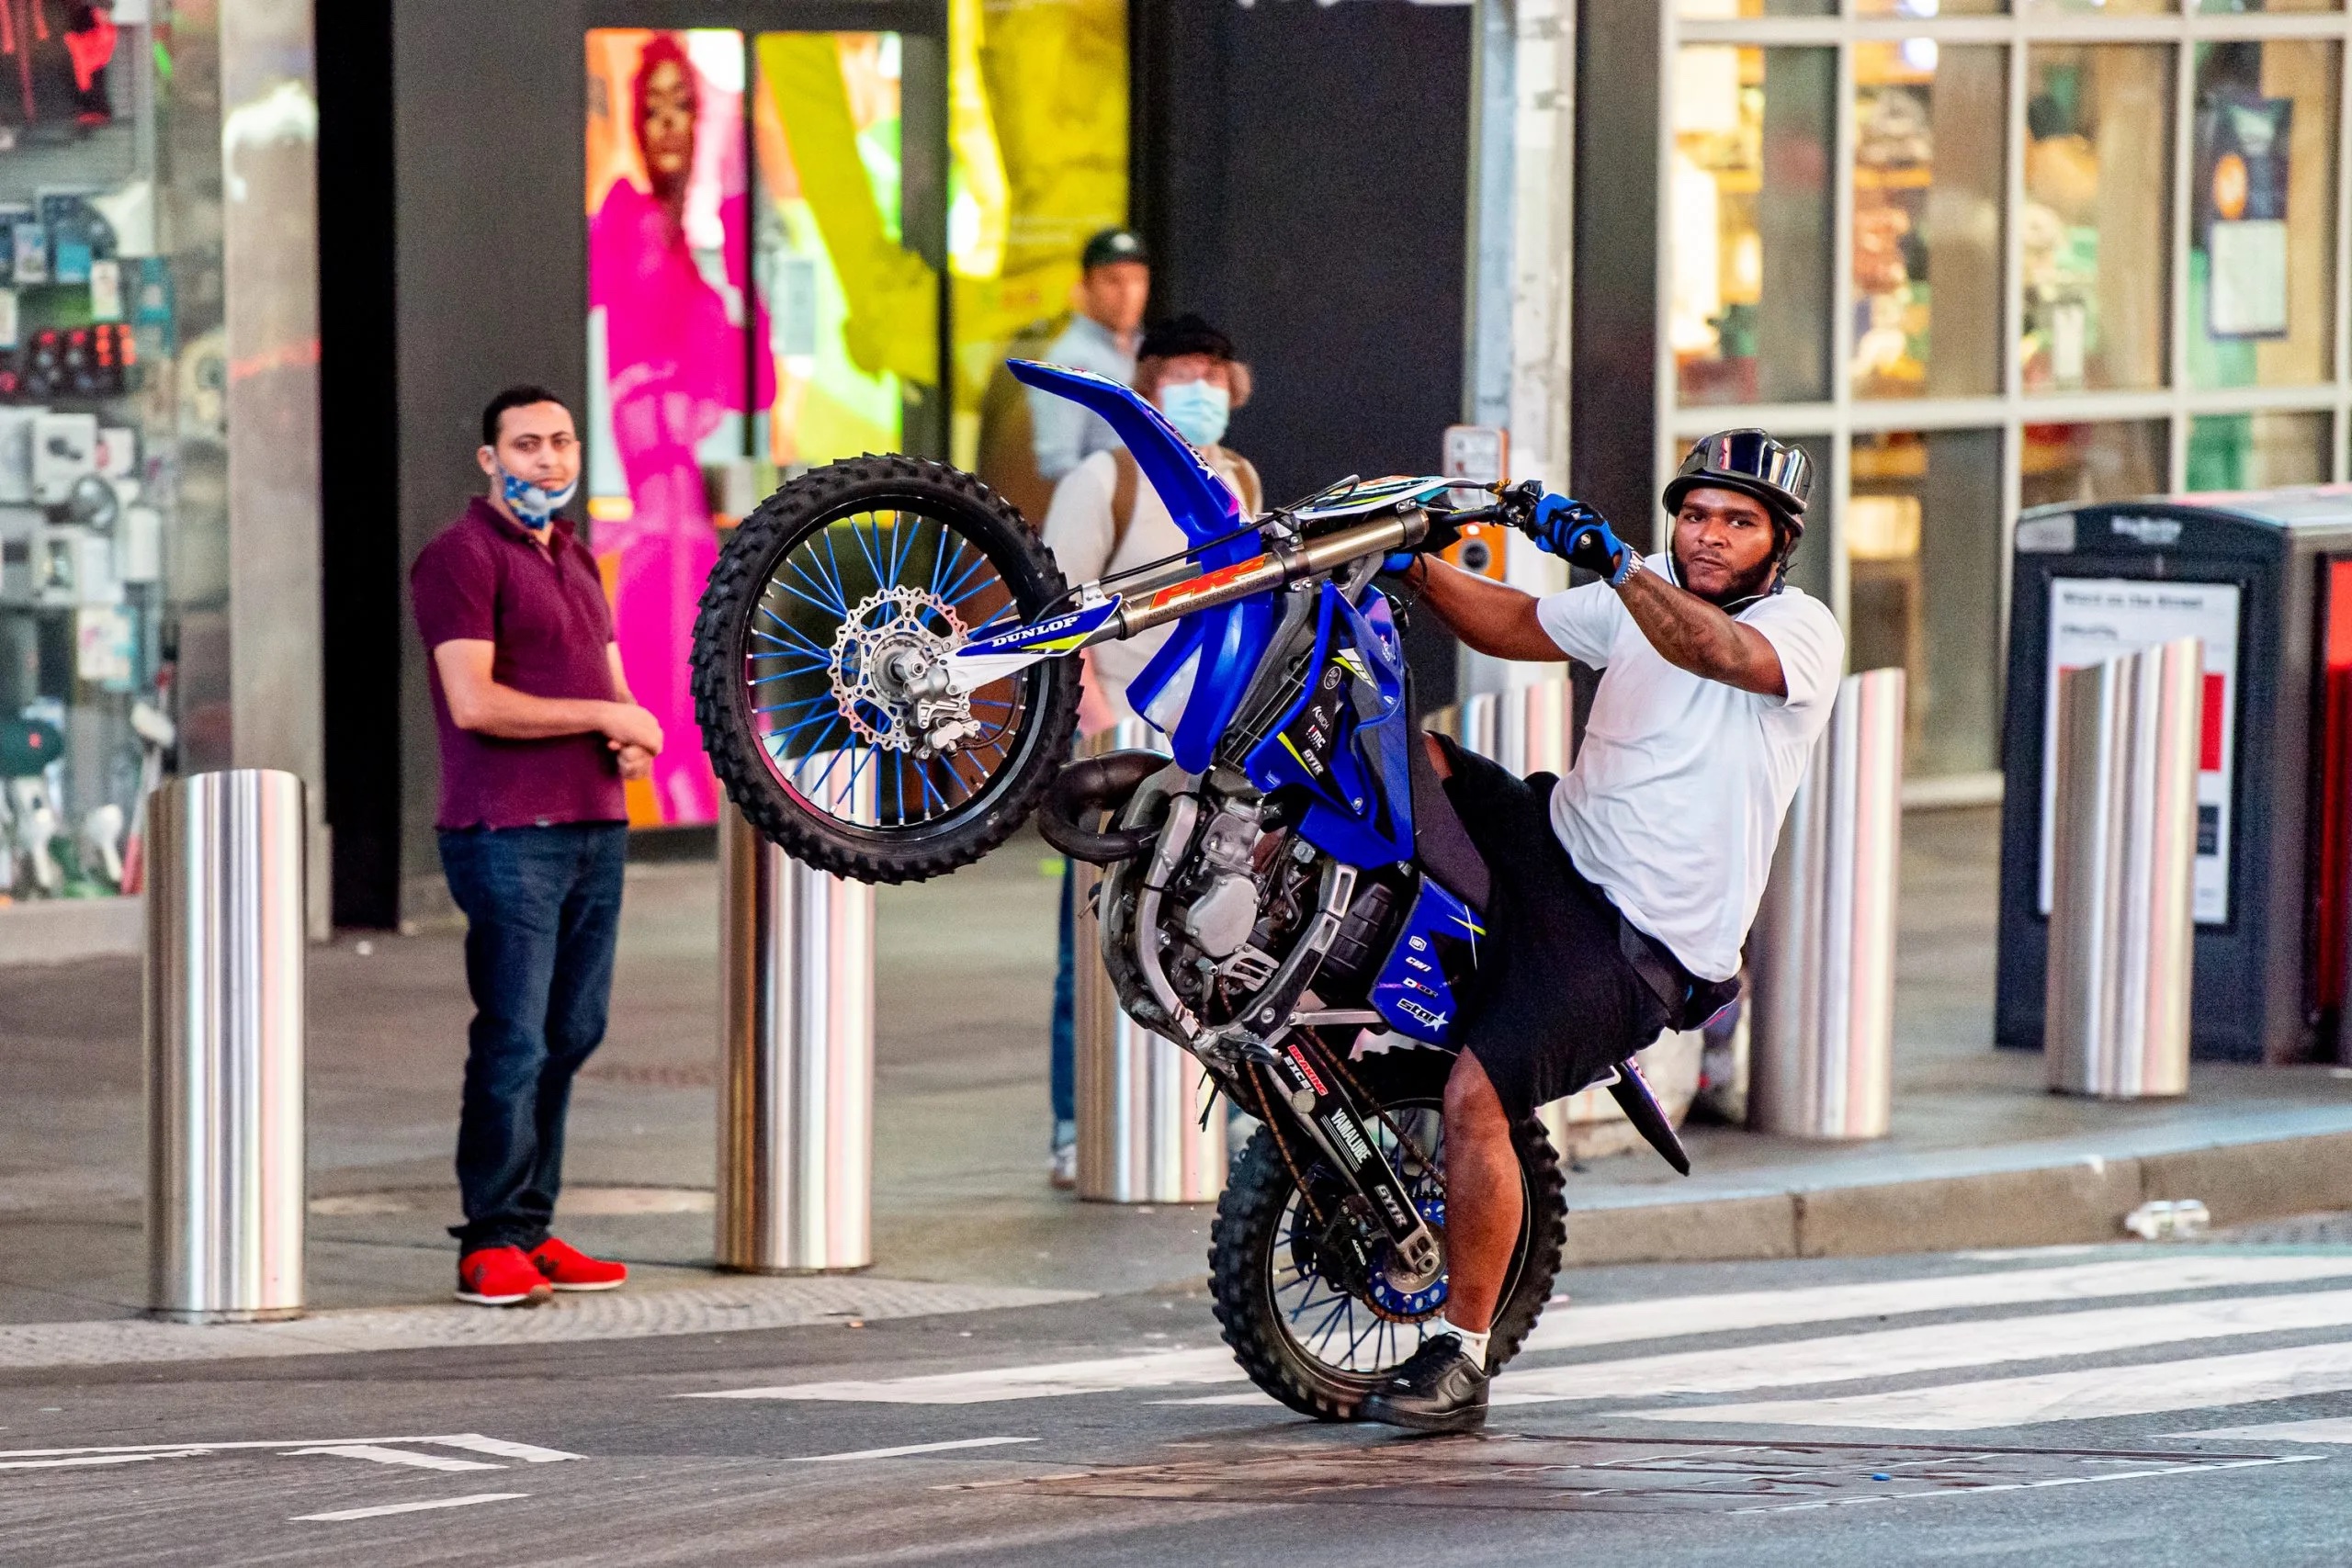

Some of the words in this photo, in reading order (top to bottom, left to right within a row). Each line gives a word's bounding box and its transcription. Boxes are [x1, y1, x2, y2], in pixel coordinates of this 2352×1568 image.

[1148, 601, 1193, 621] ADVANCED
[1193, 582, 1246, 607] SUSPENSION
[1247, 573, 1277, 592] SYSTEM
[992, 615, 1080, 648] DUNLOP
[1302, 749, 1324, 776] GYTR
[1287, 1044, 1329, 1096] BRAKING
[1331, 1108, 1373, 1164] YAMALUBE
[1374, 1184, 1408, 1227] GYTR
